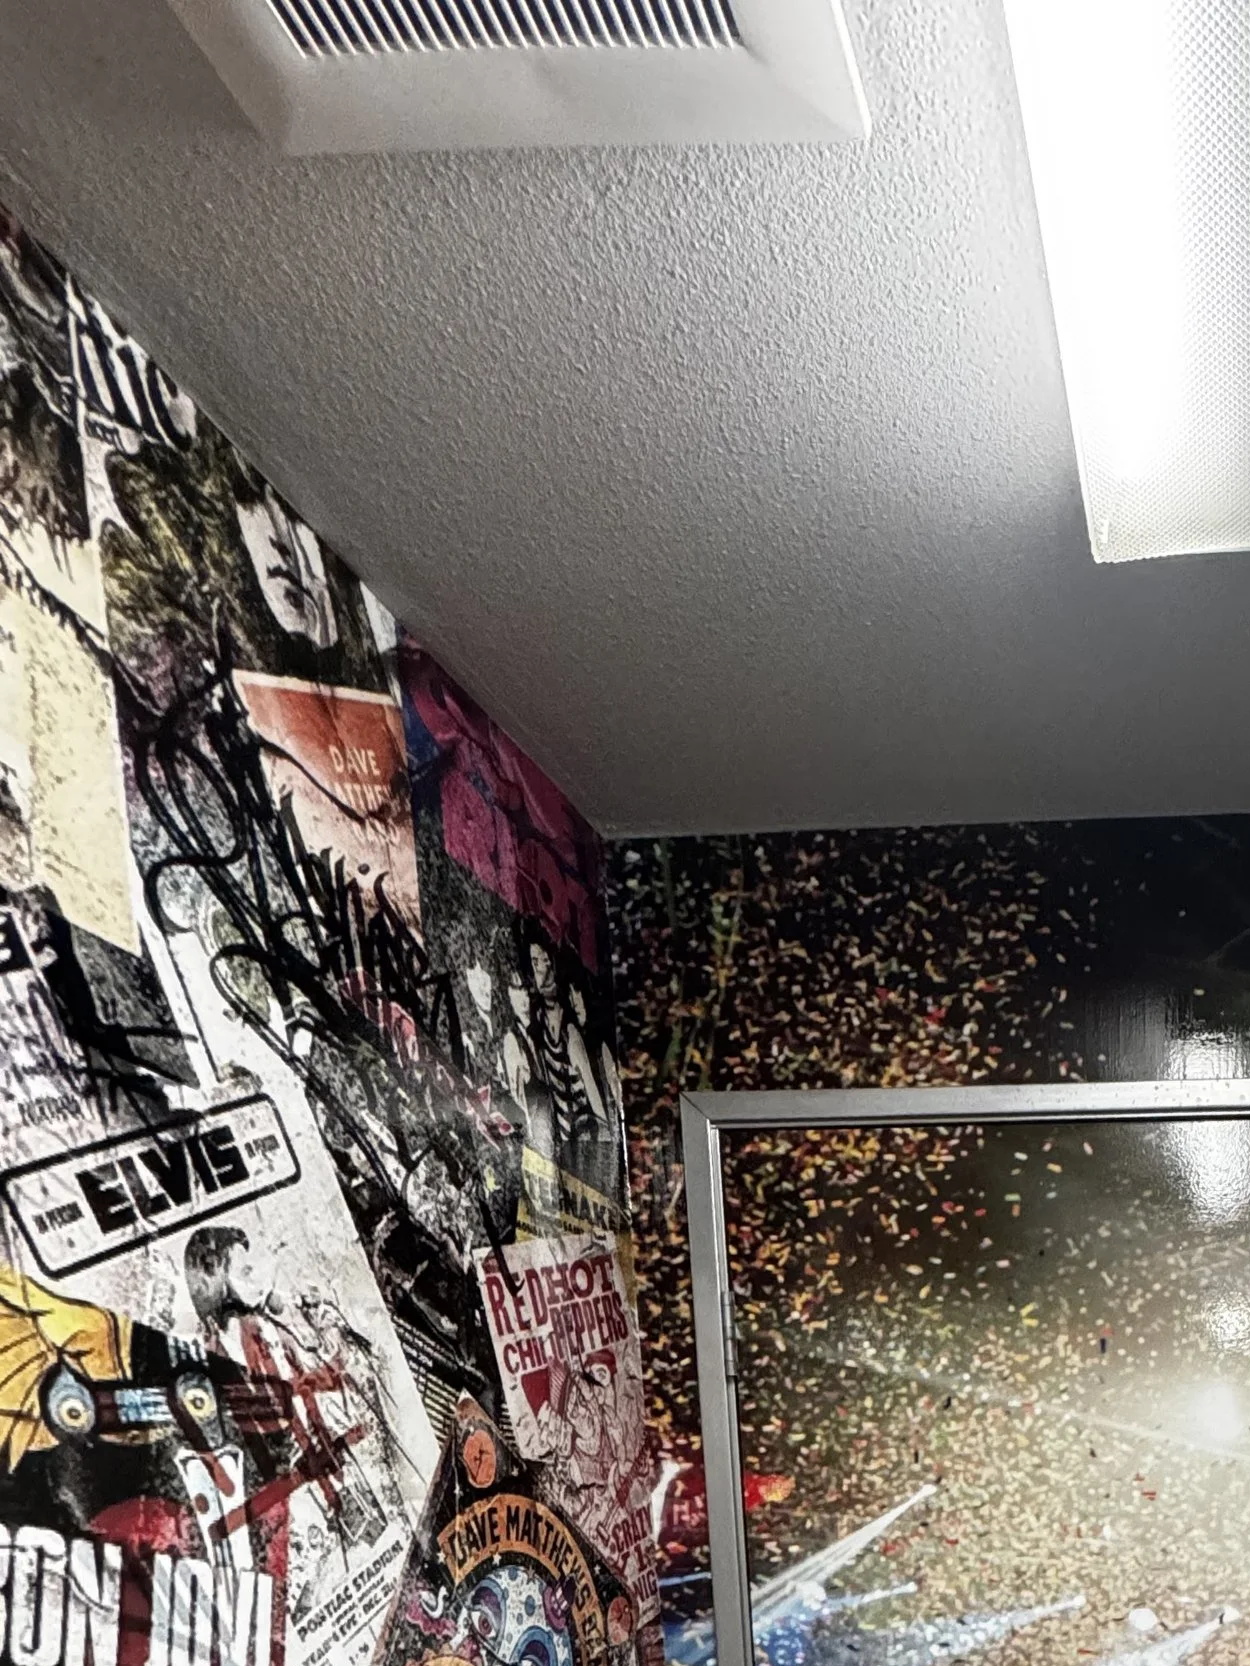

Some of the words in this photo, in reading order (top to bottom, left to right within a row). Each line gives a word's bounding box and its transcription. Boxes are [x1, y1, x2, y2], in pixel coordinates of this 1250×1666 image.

[328, 743, 382, 777] DAVE
[75, 1125, 250, 1235] ELVIS
[484, 1266, 549, 1337] RED
[541, 1253, 616, 1305] HOT
[550, 1292, 629, 1359] PEPPERS
[296, 1585, 353, 1643] PONTIAC
[351, 1539, 404, 1592] STADIUM
[448, 1506, 500, 1567] DAVE
[505, 1503, 592, 1612] MATTHEWS
